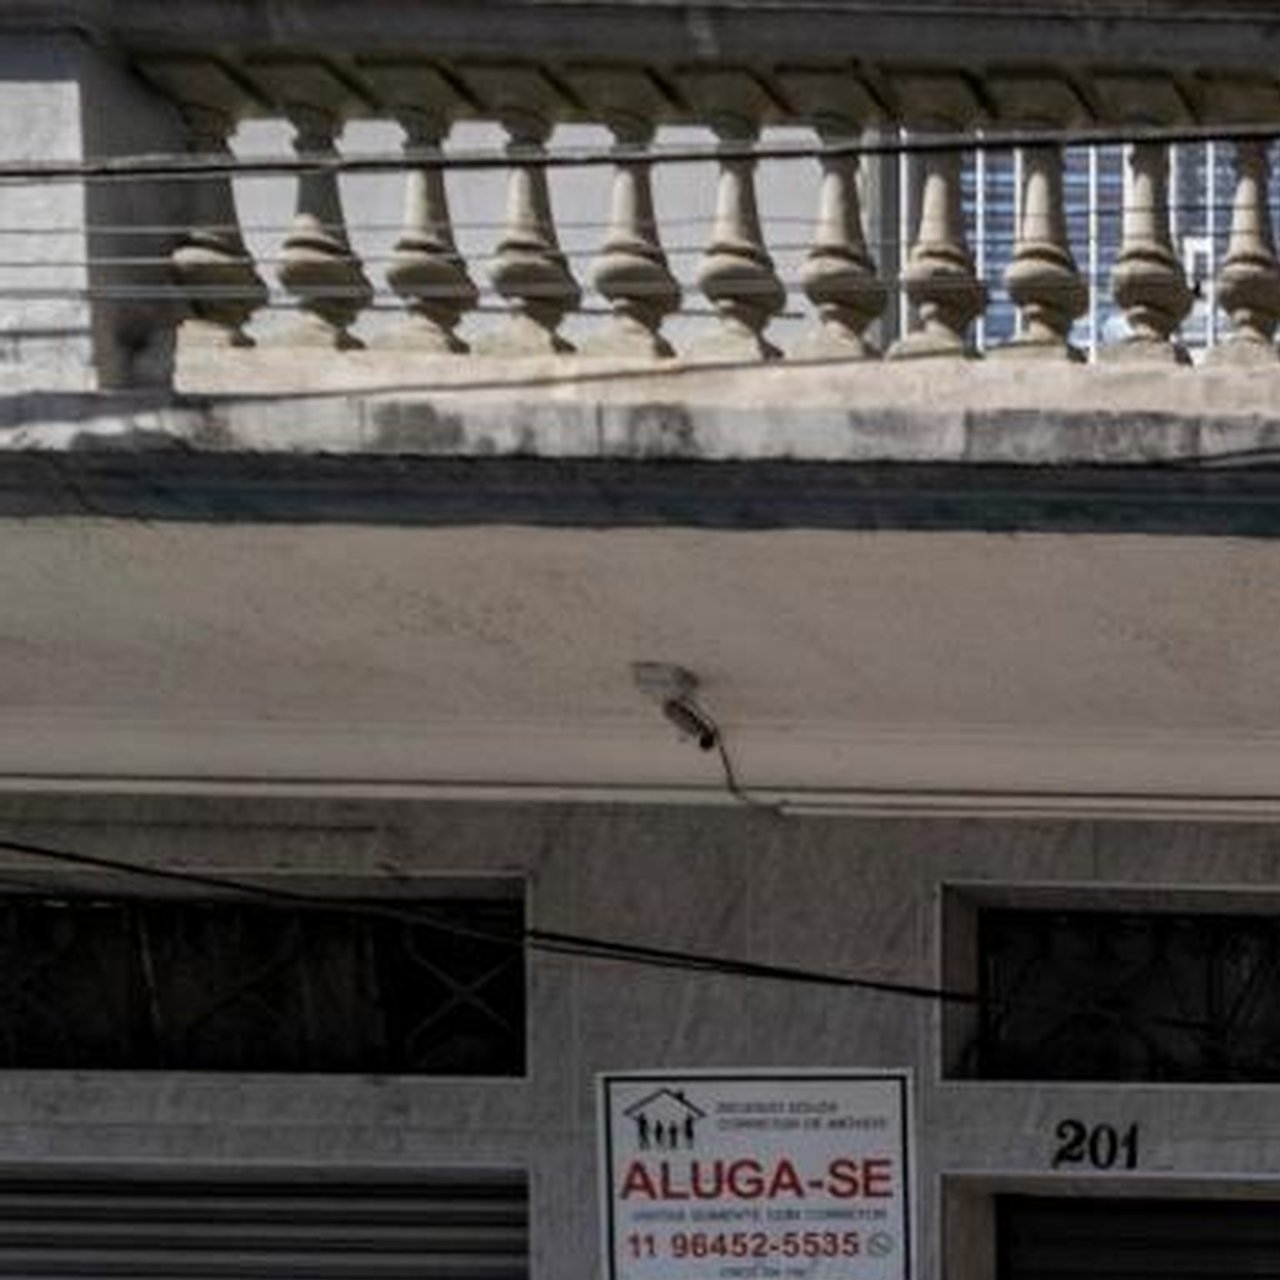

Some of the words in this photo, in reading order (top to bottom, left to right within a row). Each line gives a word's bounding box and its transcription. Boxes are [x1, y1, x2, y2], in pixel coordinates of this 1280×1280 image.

[1051, 1119, 1139, 1170] 201
[621, 1159, 894, 1200] ALUGA-SE
[627, 1233, 656, 1258] 11
[670, 1232, 860, 1258] 96452-5535
